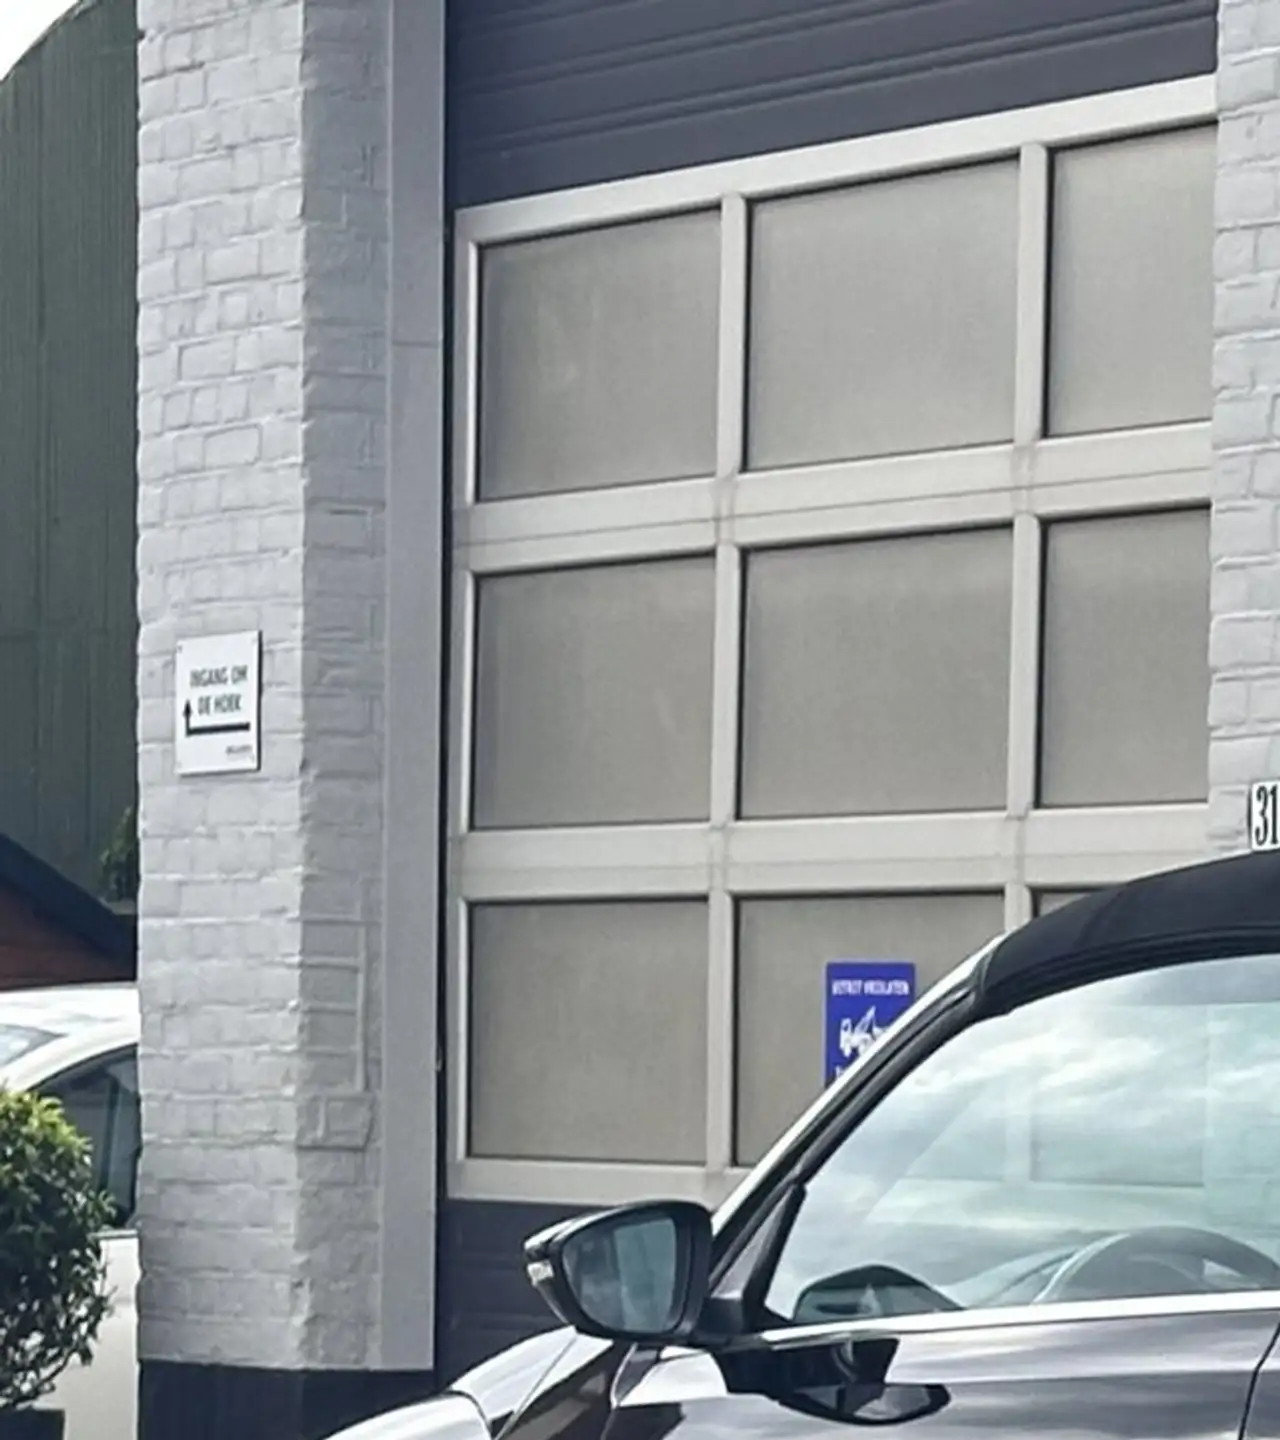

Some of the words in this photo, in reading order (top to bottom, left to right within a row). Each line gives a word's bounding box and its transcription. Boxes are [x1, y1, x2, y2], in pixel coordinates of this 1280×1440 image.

[189, 666, 229, 688] INGANG
[231, 664, 249, 685] OM
[197, 695, 211, 716] DE
[214, 693, 242, 713] HOEK
[1254, 784, 1280, 846] 31
